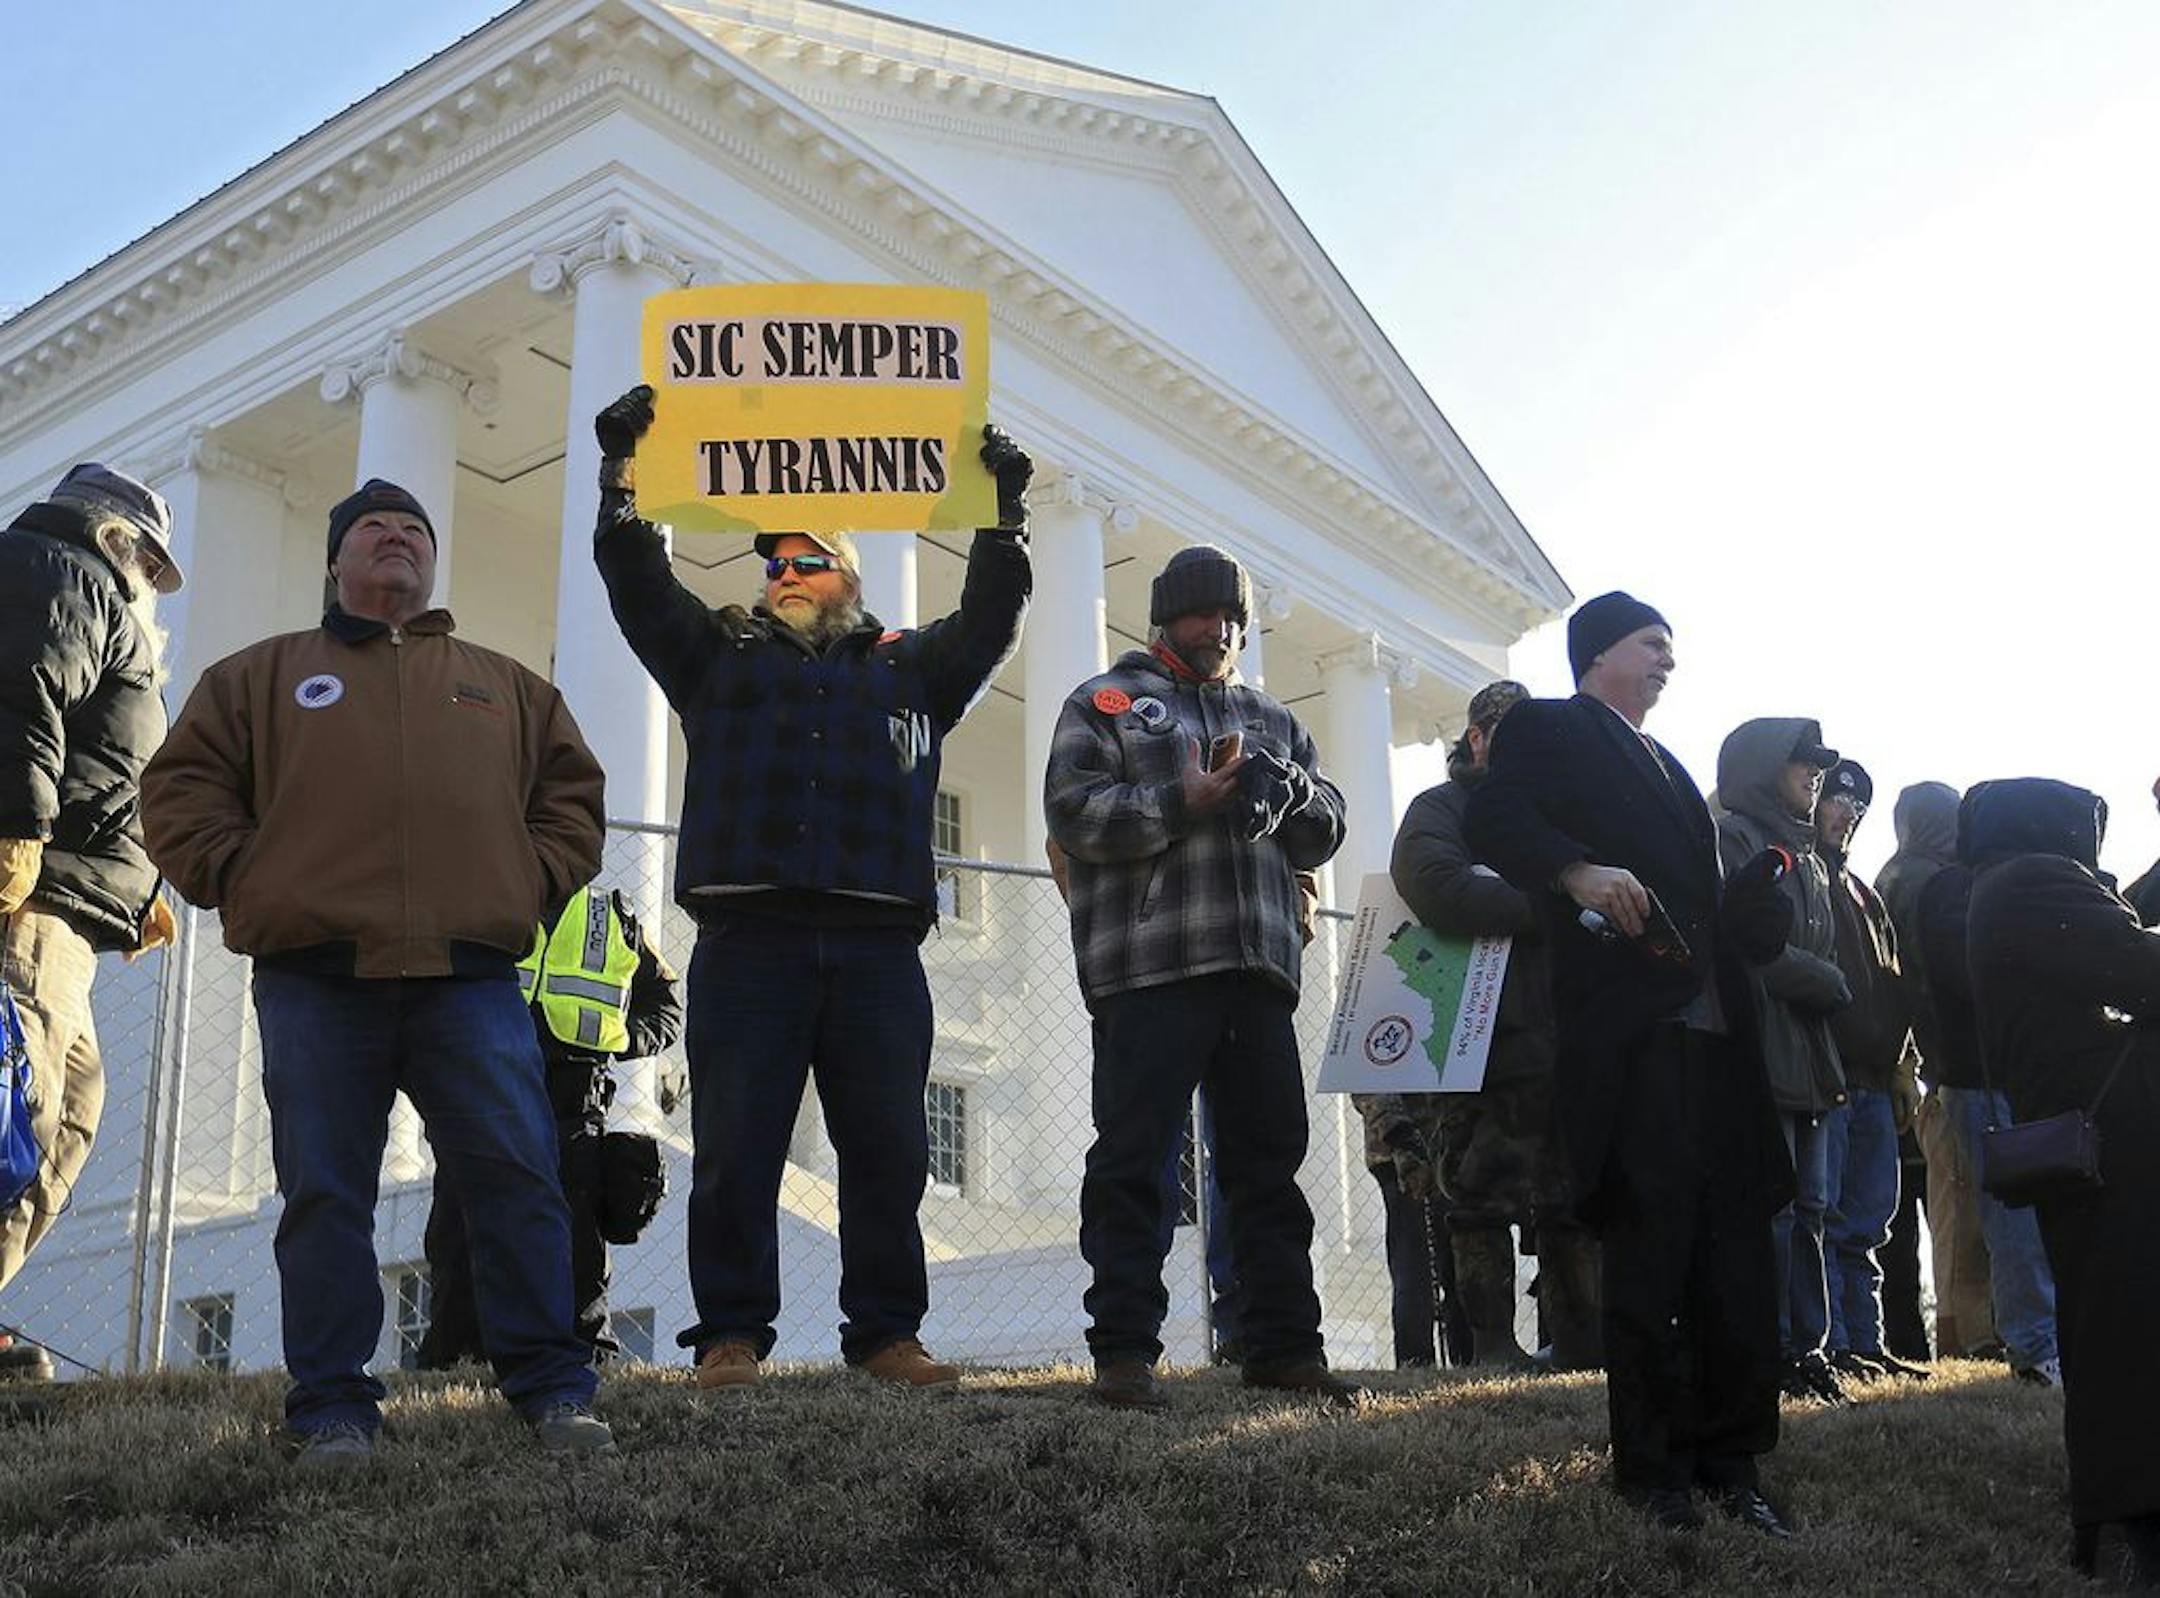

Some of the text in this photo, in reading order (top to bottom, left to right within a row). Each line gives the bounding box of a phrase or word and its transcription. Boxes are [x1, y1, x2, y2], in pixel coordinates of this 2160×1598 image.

[672, 321, 961, 380] SIC SEMPER
[700, 438, 946, 496] TYRANNIS
